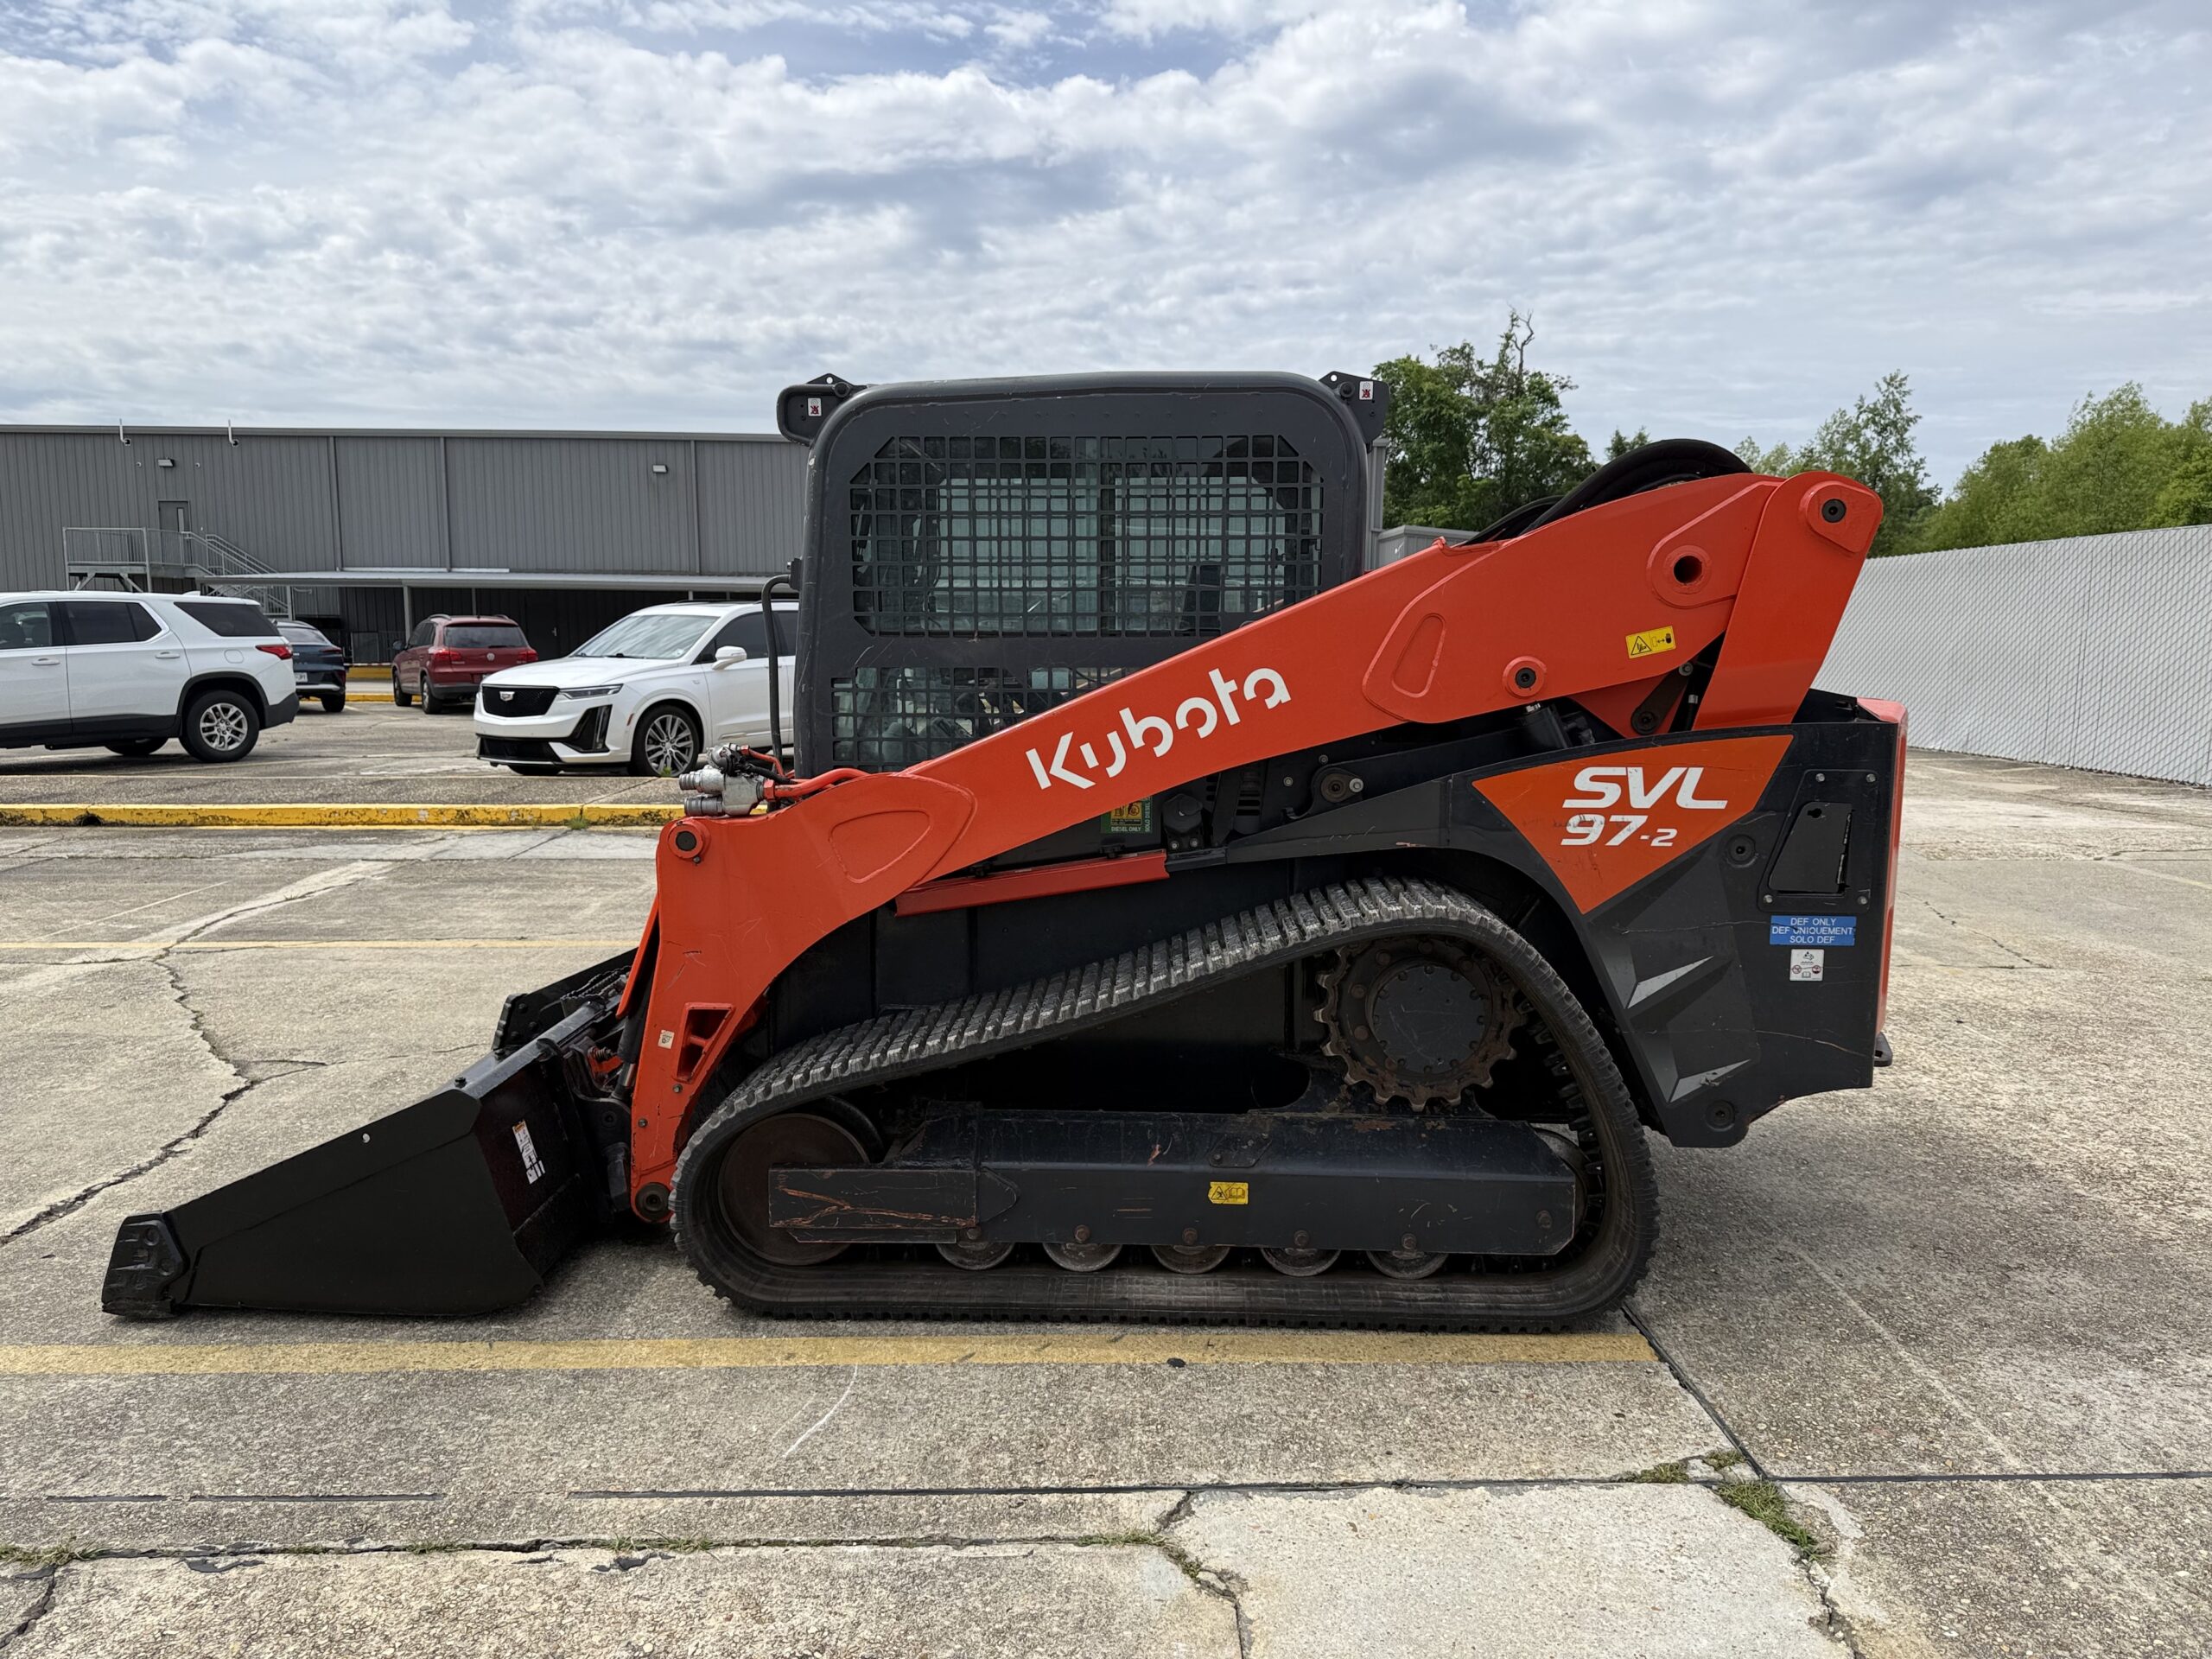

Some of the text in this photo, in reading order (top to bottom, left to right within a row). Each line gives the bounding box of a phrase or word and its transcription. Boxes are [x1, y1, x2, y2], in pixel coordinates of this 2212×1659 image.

[1026, 668, 1292, 790] Kubota
[1562, 766, 1728, 809] SVL
[1560, 814, 1678, 847] 97-2
[1793, 926, 1853, 935] UNIQUEMENT
[1812, 918, 1837, 926] ONLY
